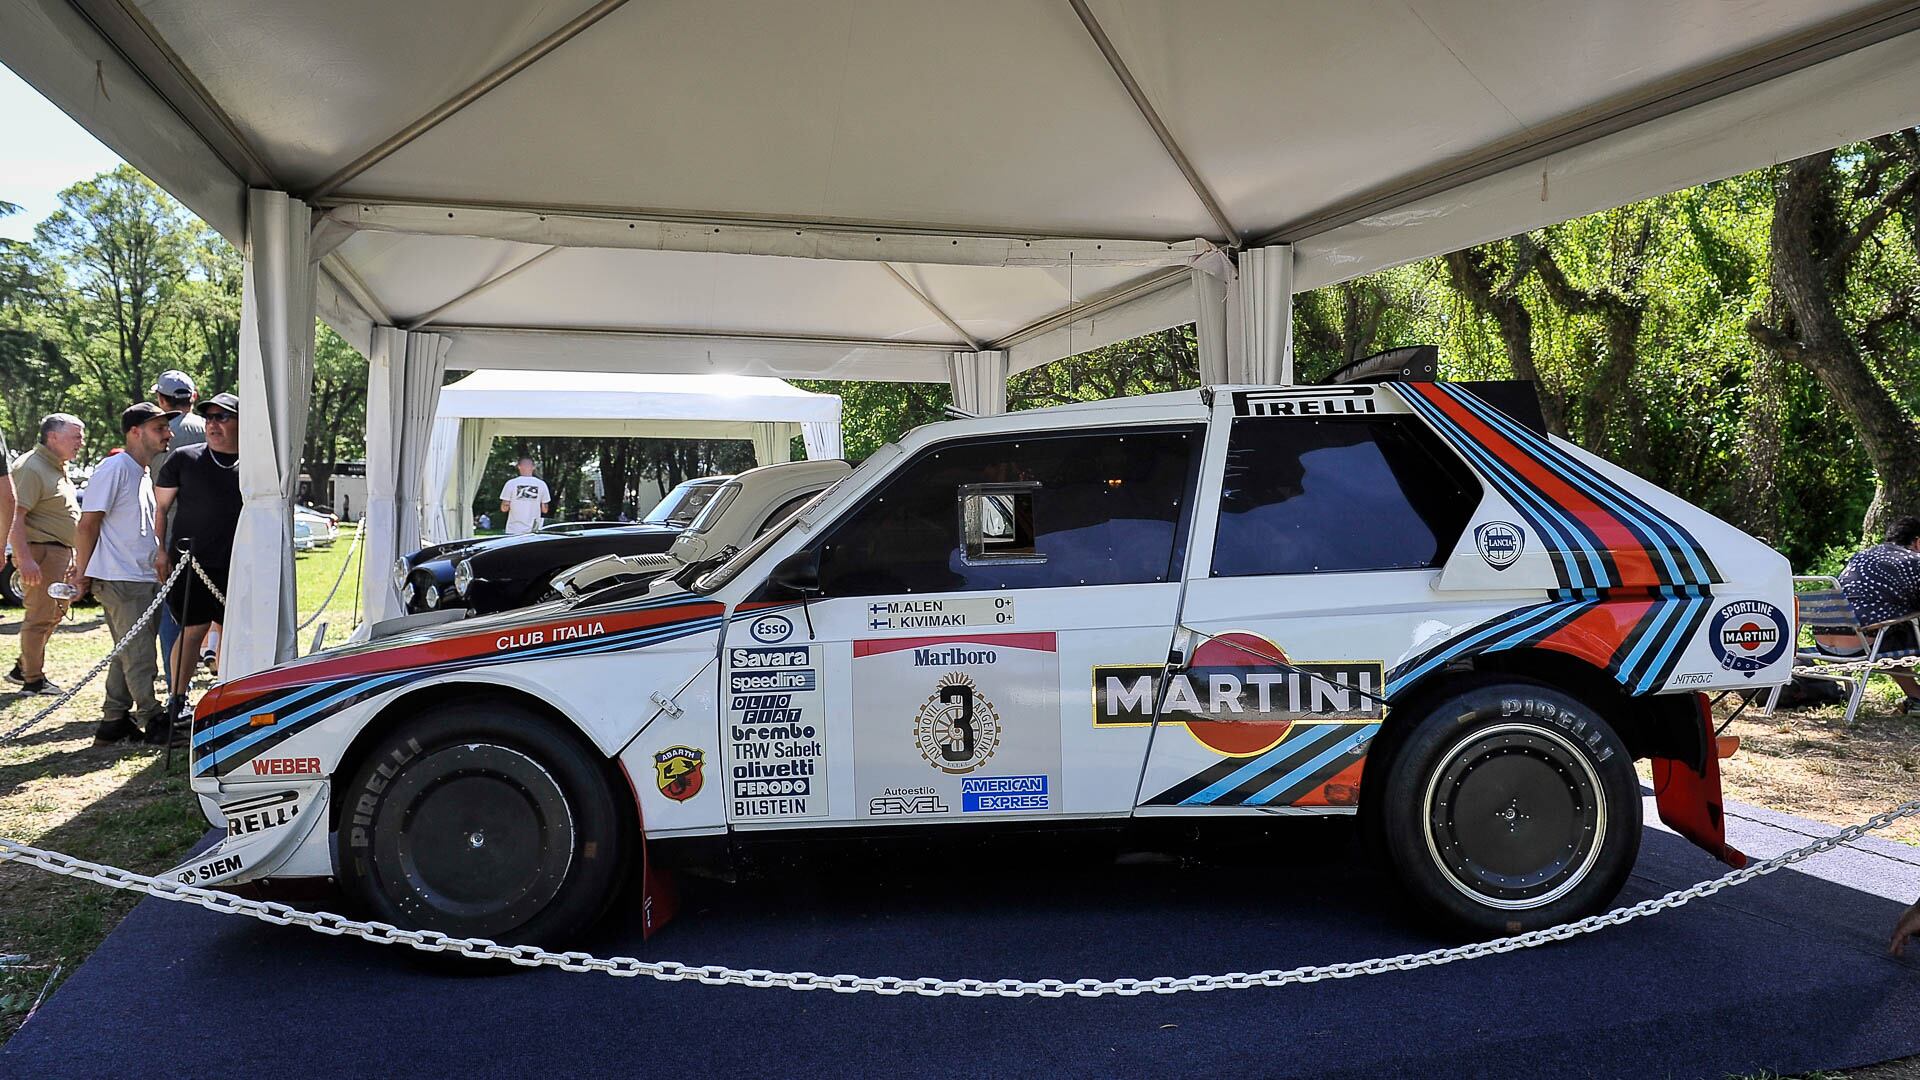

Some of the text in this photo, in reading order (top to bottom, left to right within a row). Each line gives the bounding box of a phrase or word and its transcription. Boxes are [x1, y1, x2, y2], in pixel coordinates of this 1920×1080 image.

[1231, 387, 1376, 416] PIRELLI
[1489, 538, 1513, 547] LANCIA
[888, 601, 943, 613] M.ALEN
[1722, 602, 1774, 619] SPORTLINE
[757, 622, 787, 635] Esso
[901, 614, 966, 628] KIVIMAKI
[496, 622, 605, 650] CLUB ITALIA
[1726, 630, 1775, 642] MARTINI
[733, 649, 807, 667] Savara
[914, 648, 997, 667] Marlboro
[732, 671, 806, 691] speedline
[734, 696, 788, 708] OLIO
[1106, 671, 1373, 716] MARTINI
[746, 710, 799, 722] FIAT
[940, 685, 974, 762] 3
[732, 723, 816, 740] brembo
[920, 704, 942, 760] AUTOMOVIL
[974, 702, 994, 759] ARGENTINO
[1502, 700, 1614, 762] PIRELLI
[662, 748, 695, 761] ABARTH
[732, 741, 822, 759] TRW Sabelt
[252, 758, 321, 775] WEBER
[733, 759, 814, 778] olivetti
[351, 737, 423, 847] PIRELLI
[737, 780, 807, 796] FERODO
[884, 787, 936, 796] Autoestilo
[962, 778, 1042, 794] AMERICAN
[735, 798, 806, 816] BILSTEIN
[870, 796, 949, 815] SEVEL
[979, 795, 1049, 810] EXPRESS
[222, 796, 299, 836] RELLI
[199, 854, 243, 880] SIEM
